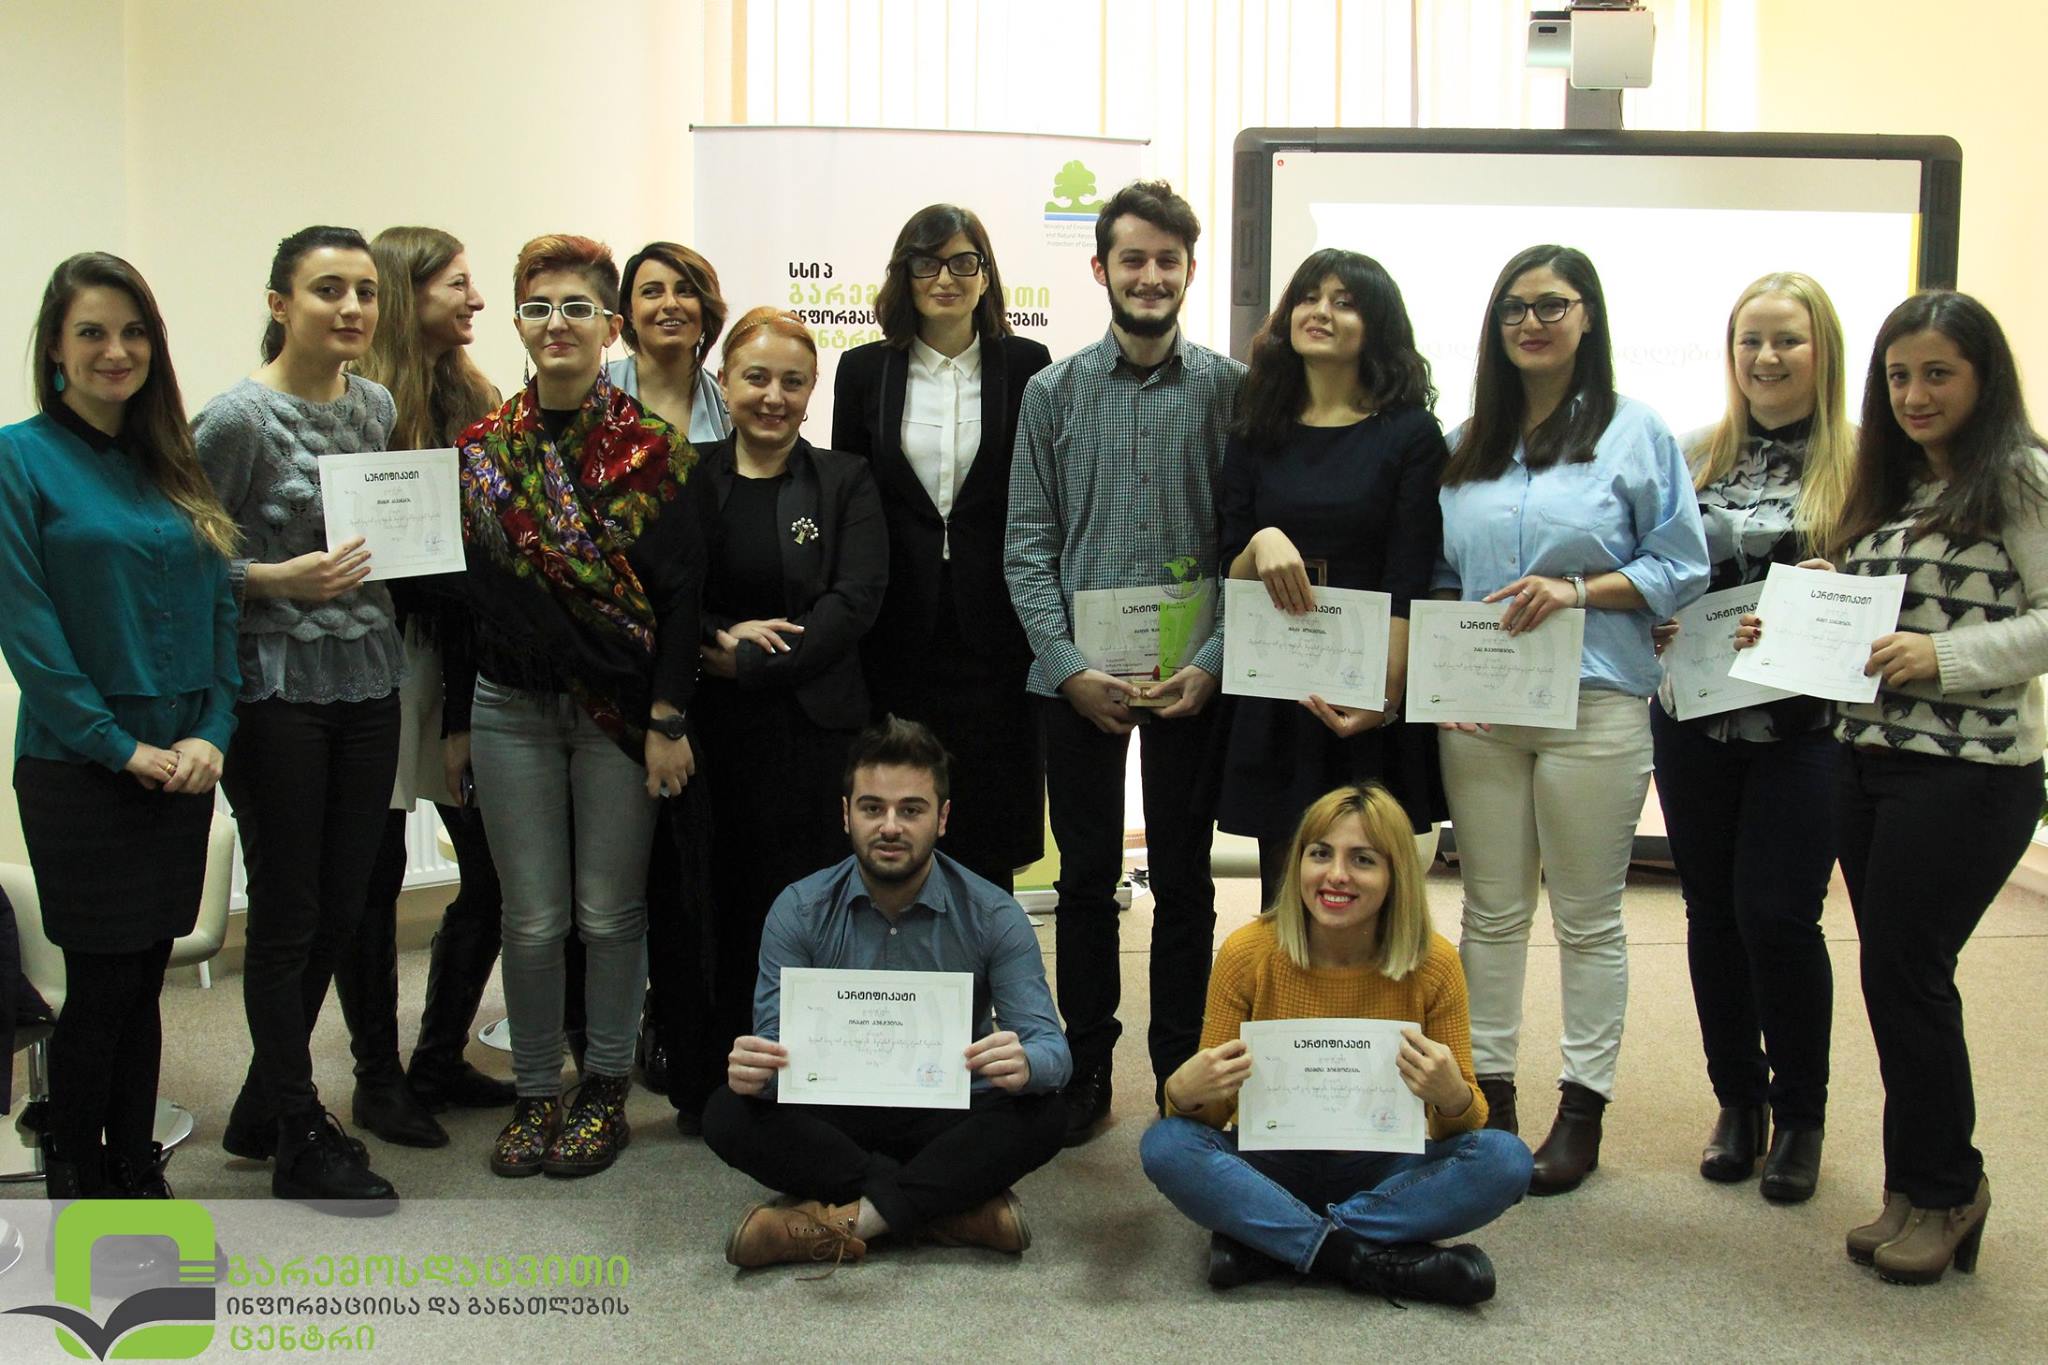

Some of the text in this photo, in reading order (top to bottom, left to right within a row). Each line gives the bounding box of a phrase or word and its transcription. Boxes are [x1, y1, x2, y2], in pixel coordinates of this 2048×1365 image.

[364, 470, 420, 482] სერტიფიკატი
[1810, 589, 1872, 605] სერტიფიკატი
[837, 990, 916, 1002] სერტიფიკატი
[1293, 1039, 1371, 1050] სერტიფიკატი
